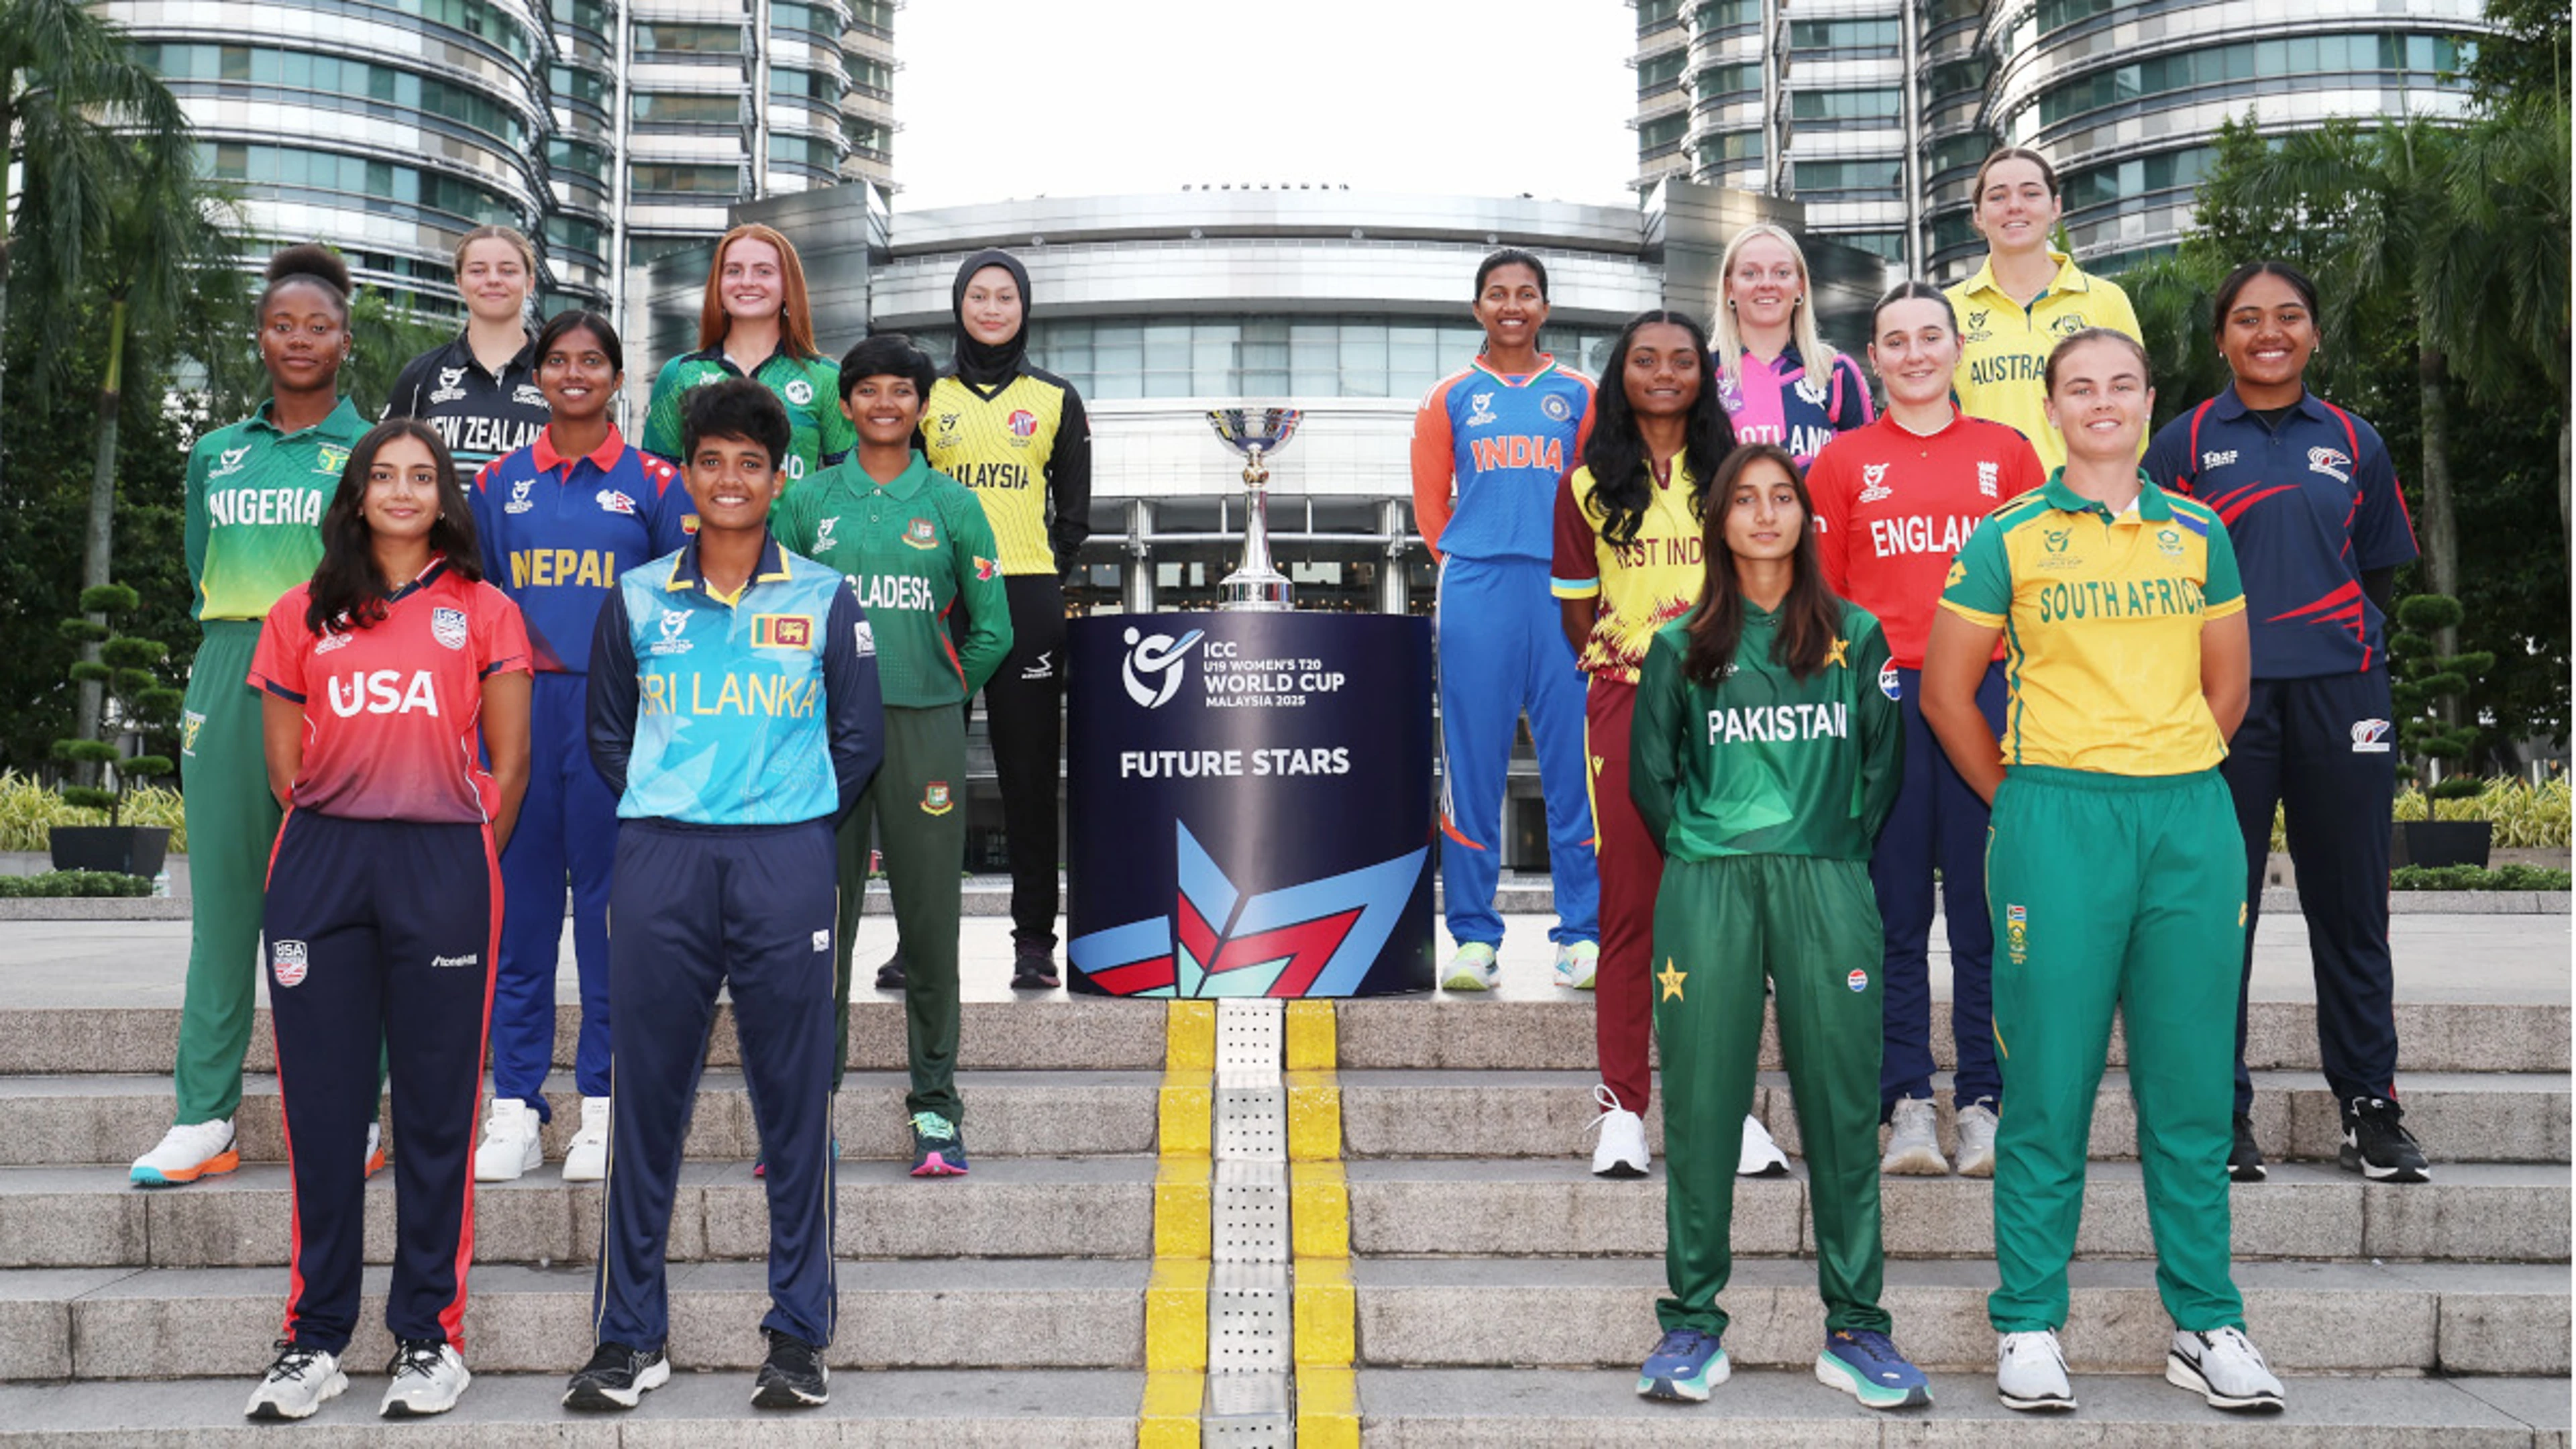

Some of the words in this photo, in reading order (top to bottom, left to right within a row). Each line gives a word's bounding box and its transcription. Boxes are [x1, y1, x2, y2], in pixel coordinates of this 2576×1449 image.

[1971, 354, 2045, 385] AUSTRA
[464, 416, 545, 451] ZEALAN
[1470, 435, 1563, 473] INDIA
[209, 487, 323, 529] NIGERIA
[1611, 538, 1660, 569] WST
[1667, 537, 1704, 566] IND
[1870, 515, 1980, 558] ENGLAN
[510, 549, 614, 589] NEPAL
[845, 574, 934, 612] LADESH
[2041, 581, 2120, 623] SOUTH
[1203, 642, 1238, 658] ICC
[1203, 661, 1226, 672] U19
[1230, 659, 1295, 671] WOMEN'S
[1298, 659, 1322, 670] T20
[328, 669, 439, 718] USA
[692, 672, 816, 718] LANKA
[1204, 673, 1293, 694] WORLD
[1299, 672, 1345, 692] CUP
[1205, 695, 1273, 707] MALAYSIA
[1276, 695, 1306, 706] 2025
[1707, 702, 1847, 745] PAKISTAN
[1121, 750, 1244, 778] FUTURE
[1251, 747, 1350, 775] STARS
[276, 943, 303, 956] USA
